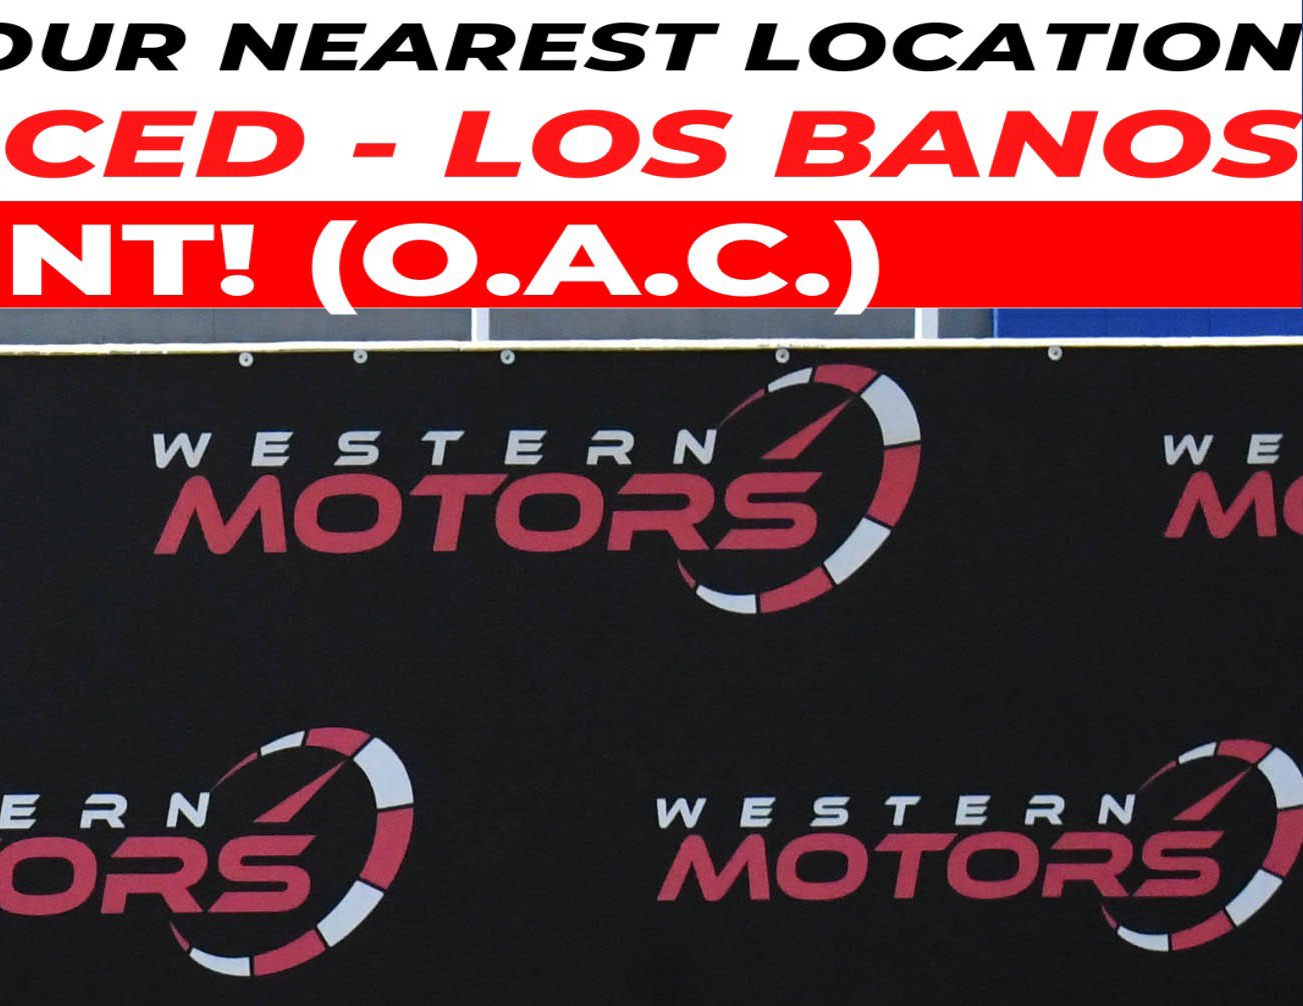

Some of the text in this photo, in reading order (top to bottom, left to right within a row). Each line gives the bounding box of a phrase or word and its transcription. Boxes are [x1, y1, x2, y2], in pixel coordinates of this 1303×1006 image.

[153, 430, 717, 469] WESTERN
[155, 472, 822, 554] MOTORS
[656, 795, 1136, 828] WESTERN
[658, 831, 1223, 901] MOTORS
